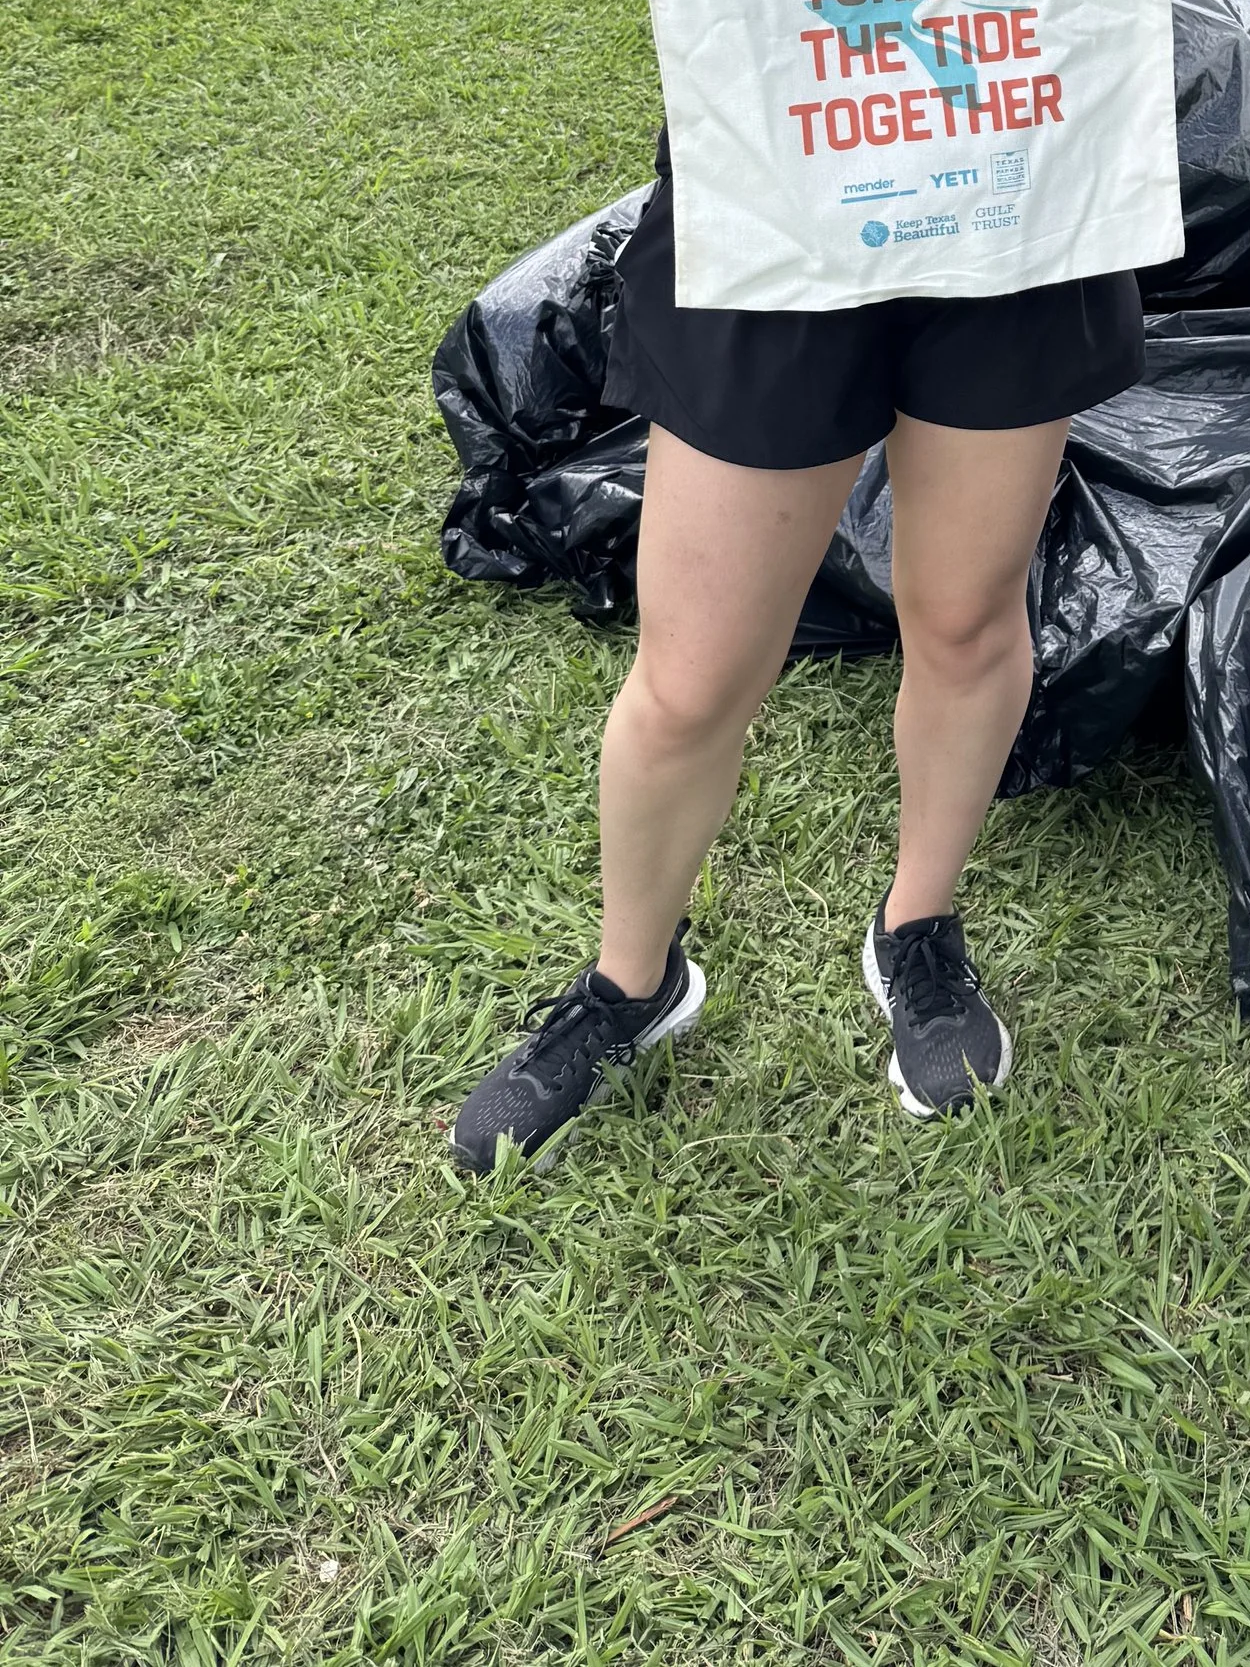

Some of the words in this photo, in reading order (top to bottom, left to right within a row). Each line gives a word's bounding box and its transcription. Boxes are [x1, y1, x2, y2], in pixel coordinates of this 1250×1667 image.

[800, 21, 907, 81] THE
[922, 8, 1042, 67] TIDE
[788, 73, 1065, 156] TOGETHER
[995, 157, 1025, 166] TEXAS
[844, 178, 895, 194] mender
[930, 168, 979, 189] YETI
[975, 203, 1016, 218] GULF
[895, 219, 923, 231] Keep
[925, 213, 956, 226] Texas
[971, 215, 1021, 231] TRUST
[893, 222, 960, 243] Beautiful
